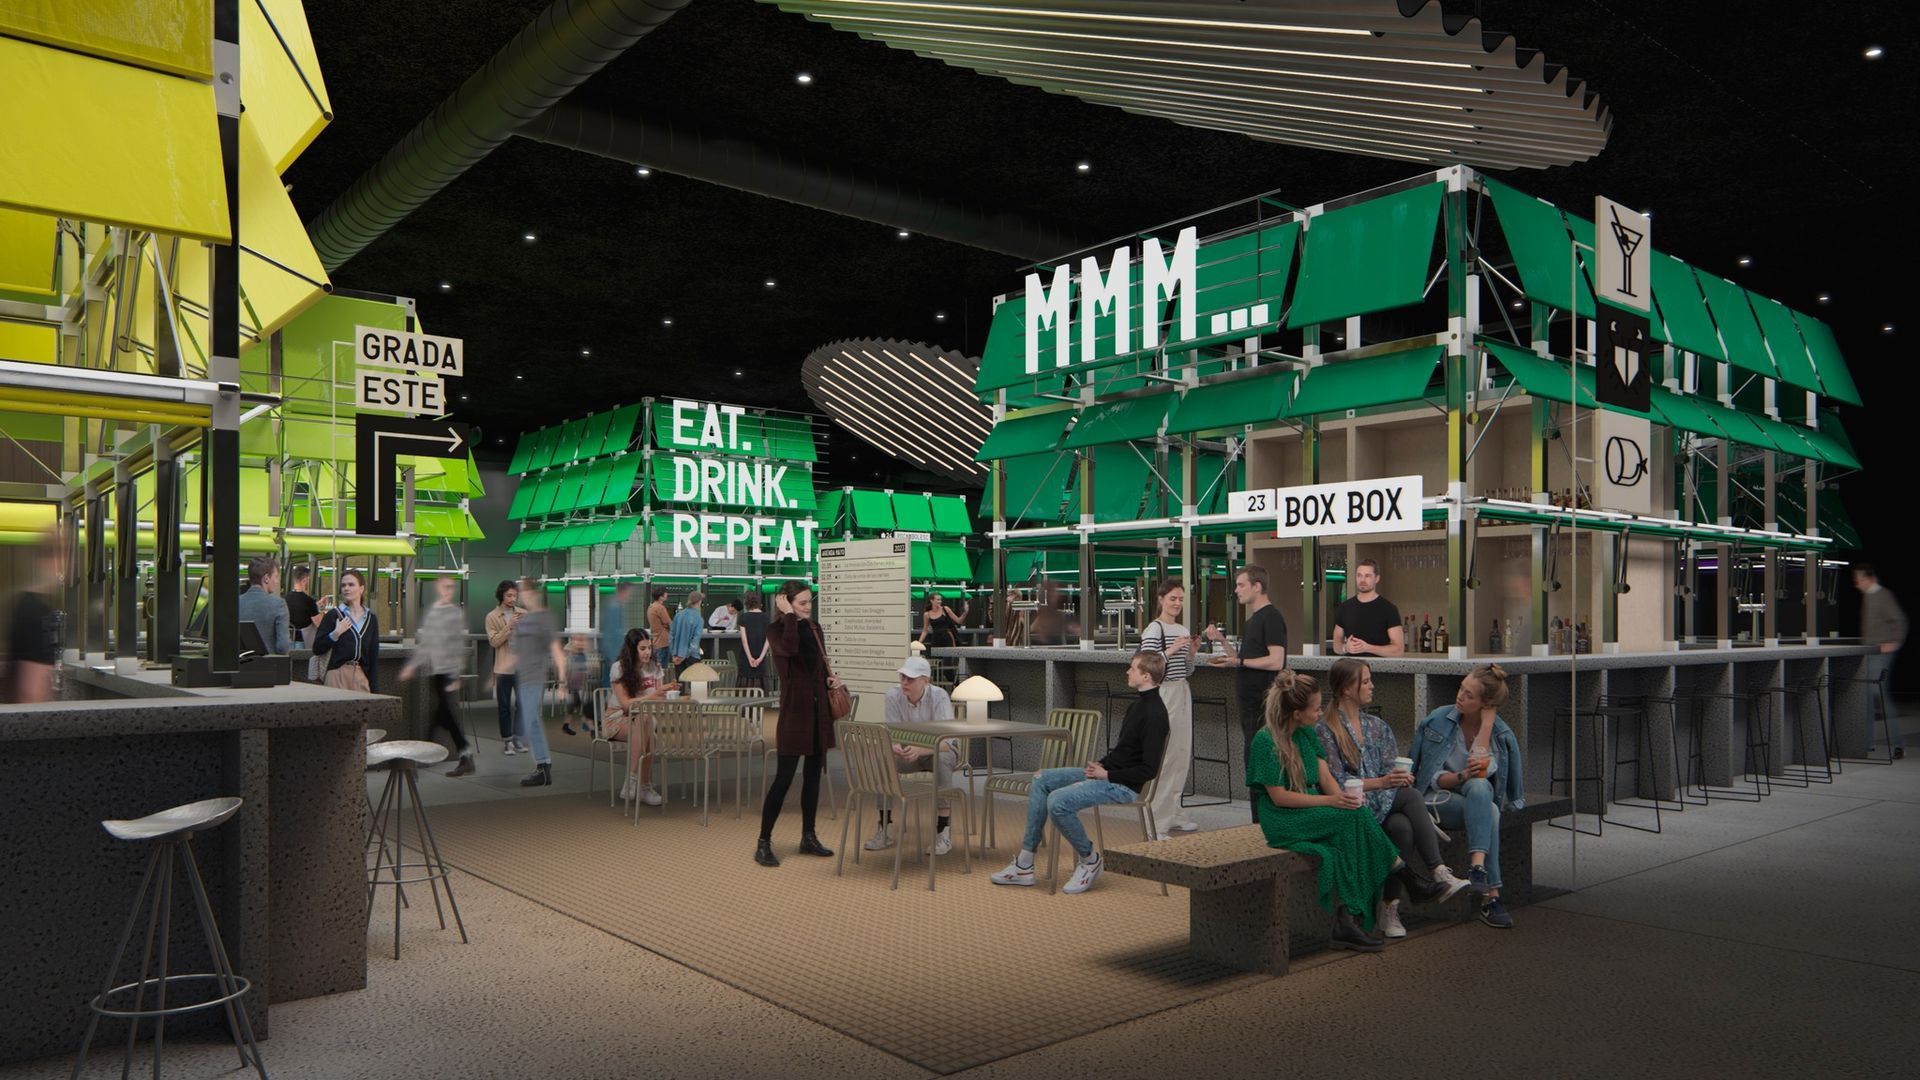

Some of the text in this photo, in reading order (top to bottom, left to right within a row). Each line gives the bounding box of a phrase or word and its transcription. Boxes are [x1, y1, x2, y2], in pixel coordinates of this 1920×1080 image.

[1025, 226, 1268, 375] MMM...
[363, 333, 457, 370] GRADA
[364, 376, 439, 410] ESTE
[673, 399, 752, 451] EAT.
[673, 456, 798, 508] DRINK.
[1247, 494, 1266, 512] 23
[1285, 487, 1403, 527] BOX BOX
